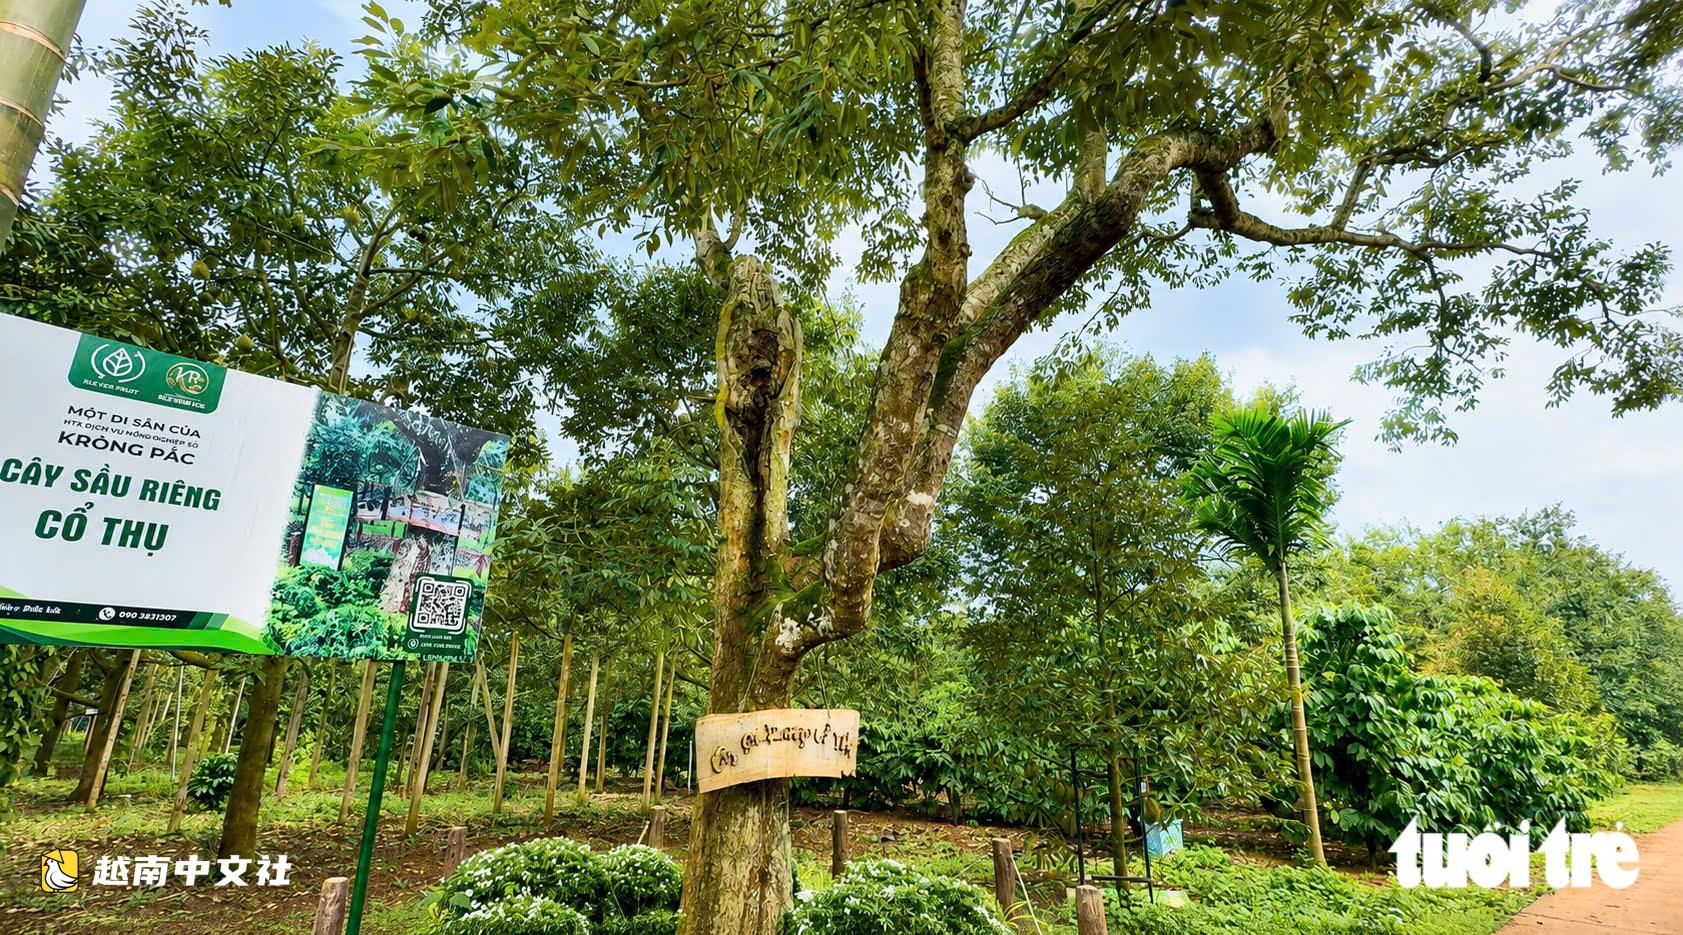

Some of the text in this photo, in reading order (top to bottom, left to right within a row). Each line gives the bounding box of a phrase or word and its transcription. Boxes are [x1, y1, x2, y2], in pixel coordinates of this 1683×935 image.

[63, 419, 83, 428] HTX
[110, 414, 128, 425] DI
[0, 456, 222, 511] CÂY SẦU RIÊNG
[34, 501, 170, 557] CỔ THỤ
